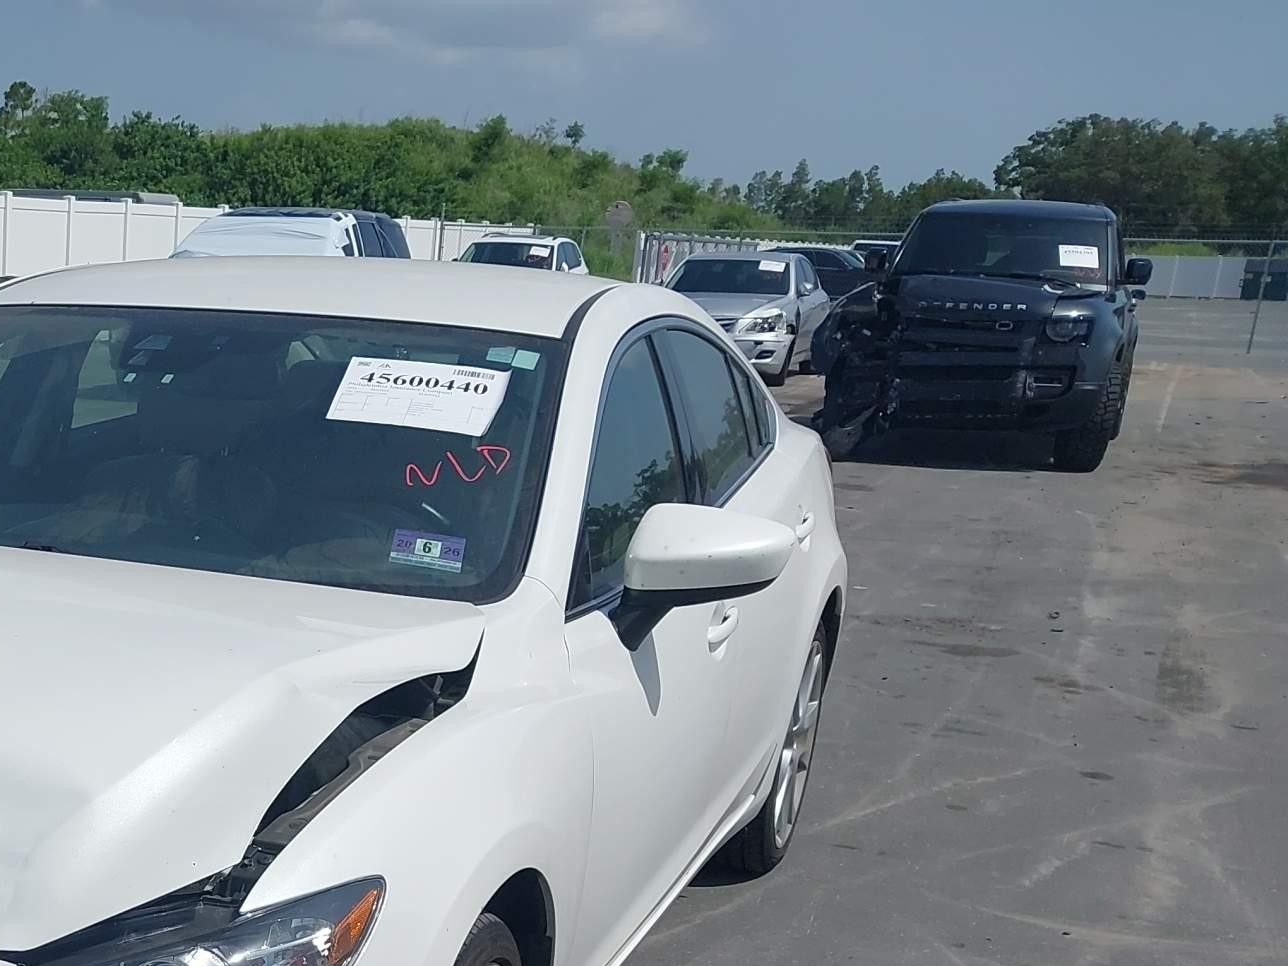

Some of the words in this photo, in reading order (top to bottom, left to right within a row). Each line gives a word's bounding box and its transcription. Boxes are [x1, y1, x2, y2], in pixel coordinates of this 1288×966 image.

[360, 371, 488, 396] 45600440
[422, 541, 433, 554] 6
[442, 545, 461, 557] 26
